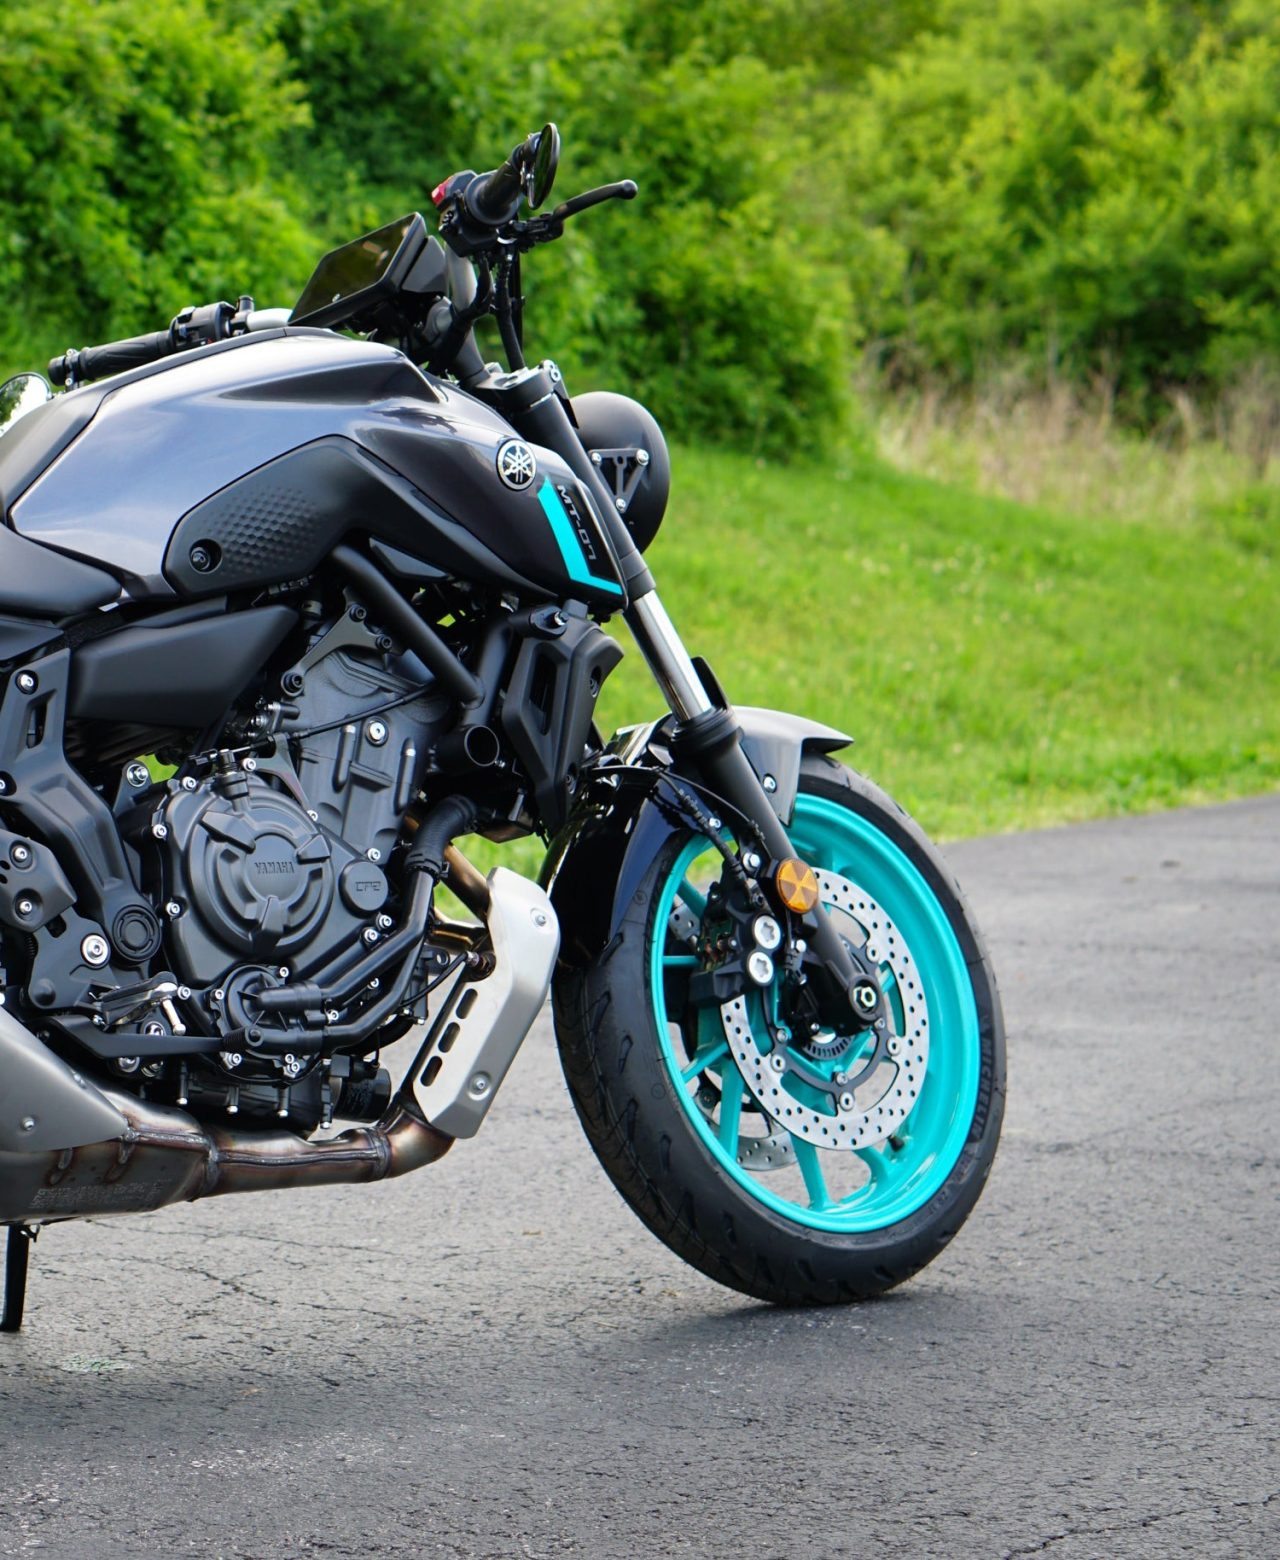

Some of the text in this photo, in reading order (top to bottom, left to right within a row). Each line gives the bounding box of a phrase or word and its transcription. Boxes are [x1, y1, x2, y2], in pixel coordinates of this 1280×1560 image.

[556, 484, 597, 560] MT-07
[254, 861, 295, 875] YAMAHA
[969, 1037, 992, 1141] MICHELIN
